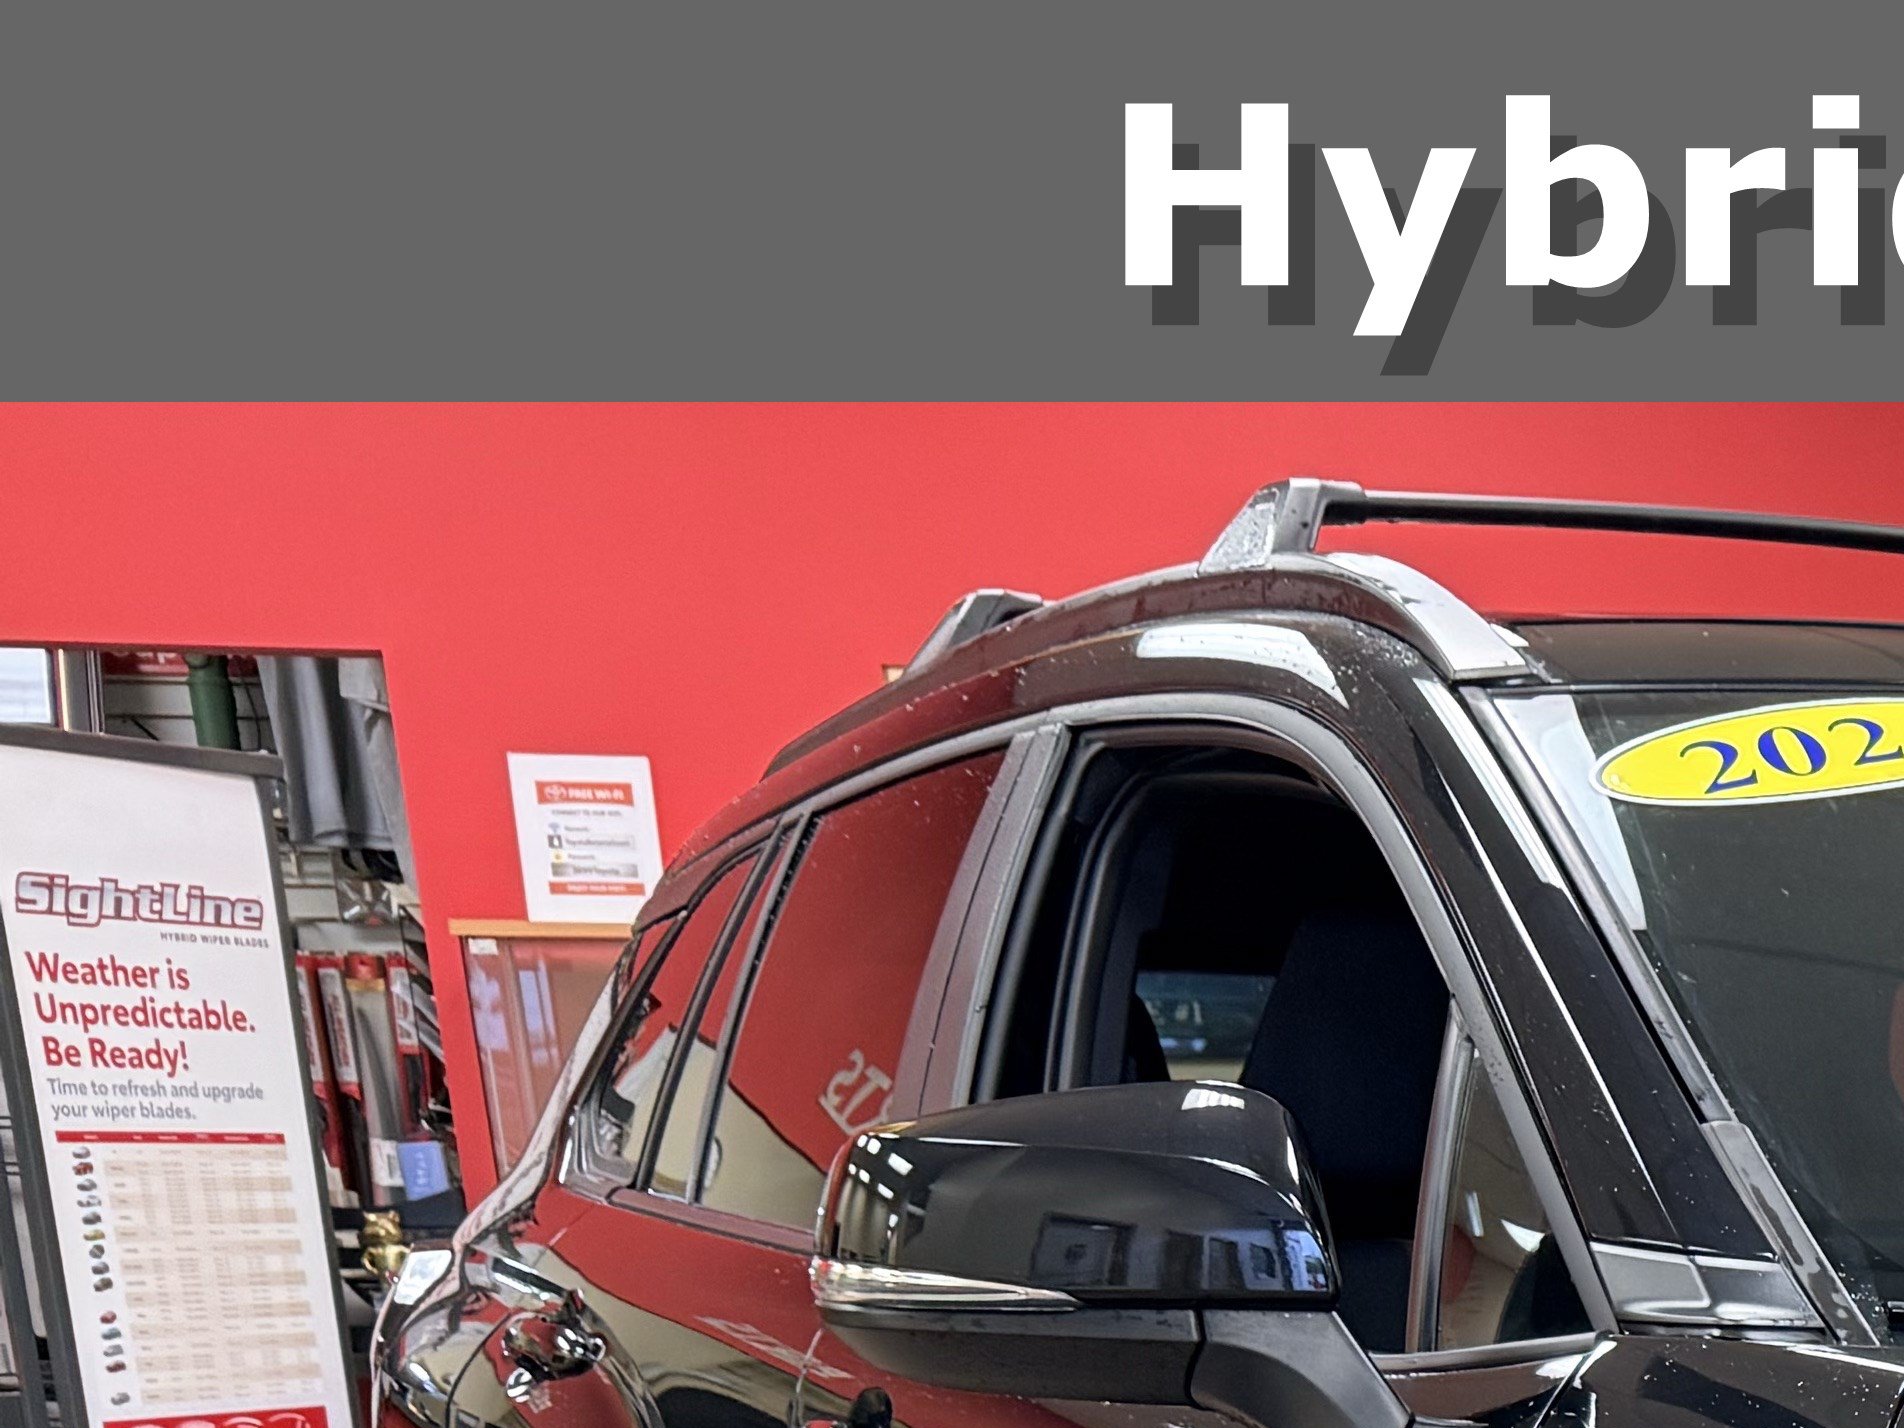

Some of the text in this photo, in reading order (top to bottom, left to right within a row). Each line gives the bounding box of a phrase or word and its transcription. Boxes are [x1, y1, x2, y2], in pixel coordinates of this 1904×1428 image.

[15, 871, 264, 931] SightLine
[25, 951, 190, 990] Weather is
[34, 992, 256, 1033] Unpredictable.
[42, 1035, 189, 1078] Be Ready!
[47, 1078, 264, 1103] Time to refresh and upgrade
[51, 1101, 196, 1122] your wiper blades.
